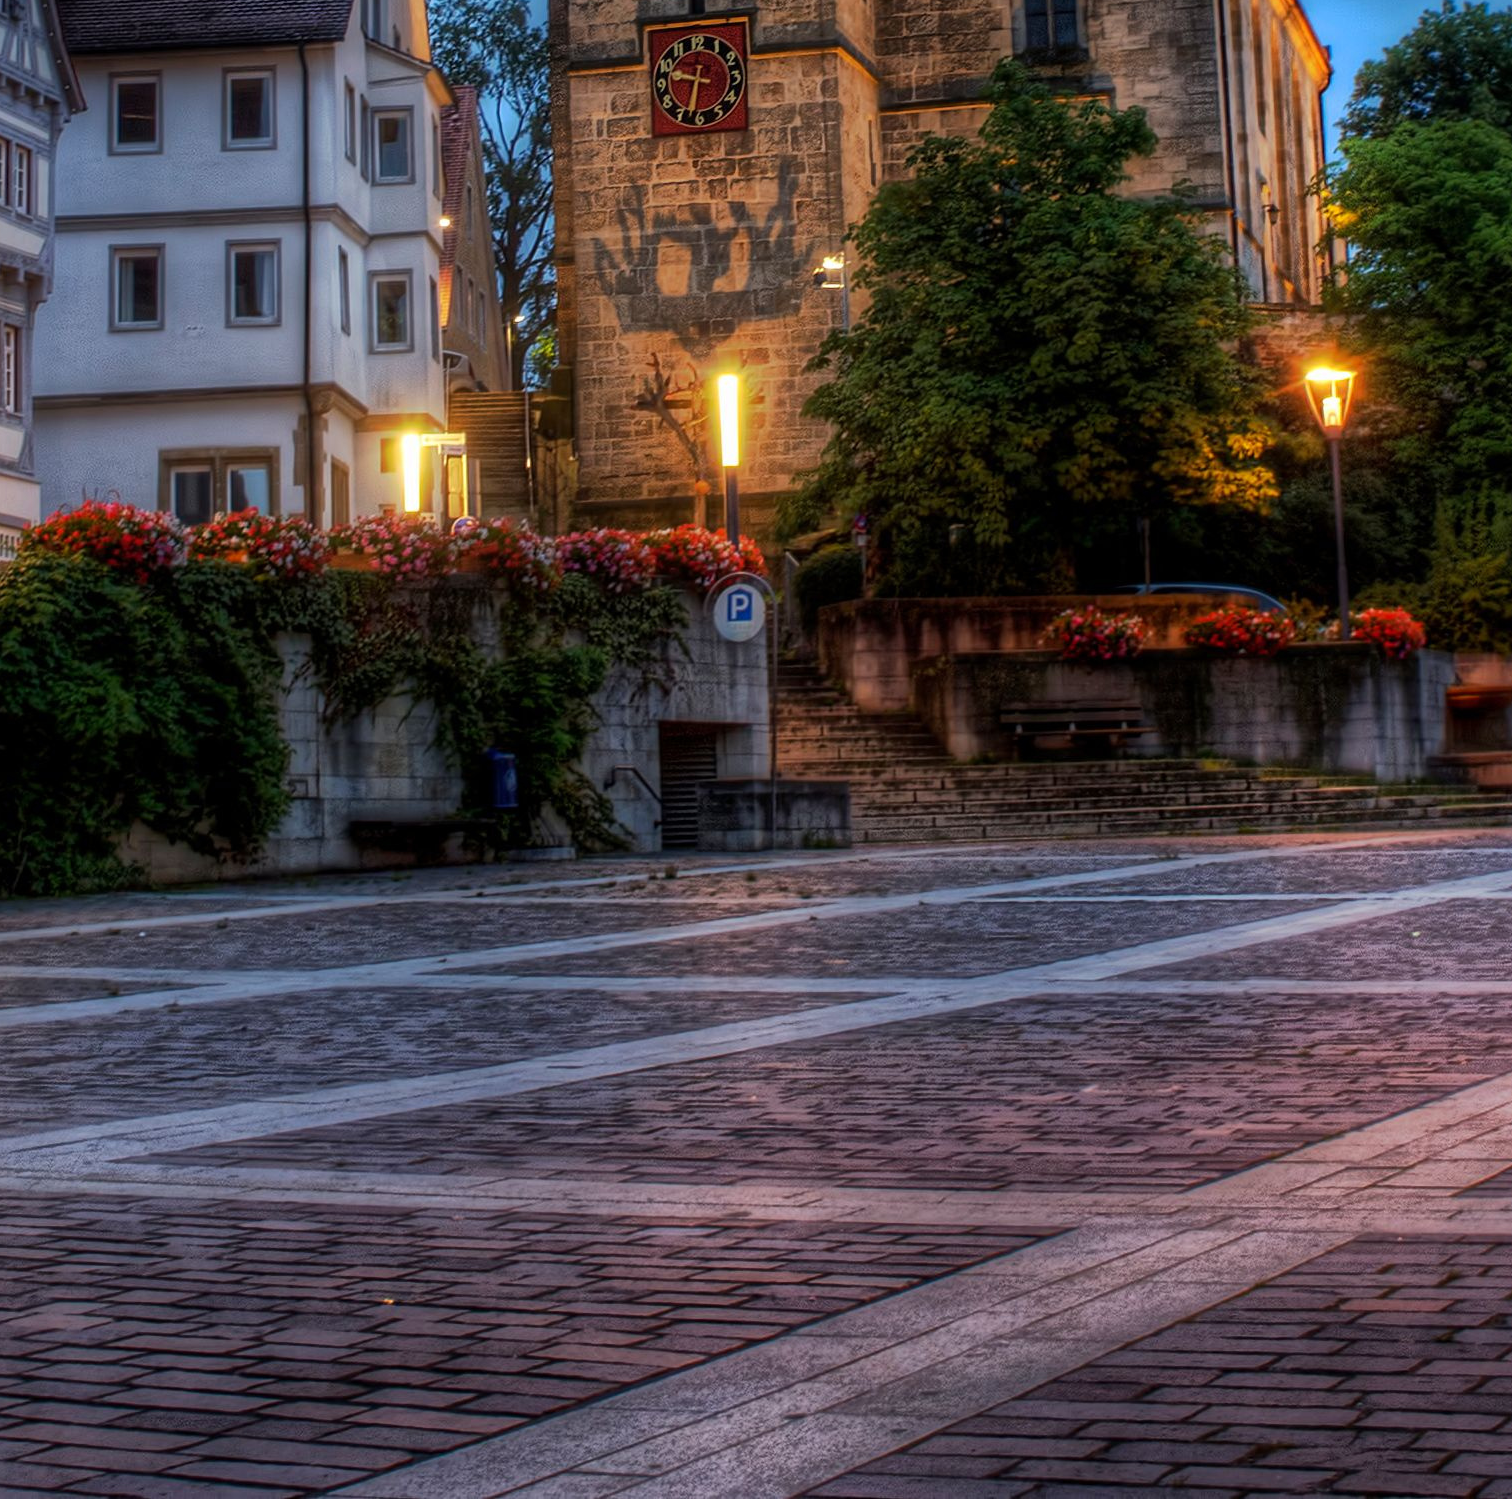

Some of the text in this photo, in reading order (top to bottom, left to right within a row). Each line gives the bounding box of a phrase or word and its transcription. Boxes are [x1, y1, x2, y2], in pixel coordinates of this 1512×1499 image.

[674, 43, 684, 57] 11
[691, 36, 705, 50] 12
[713, 40, 720, 53] 1
[660, 58, 673, 73] 10
[726, 51, 736, 66] 2
[730, 70, 741, 85] 3
[657, 78, 666, 92] 9
[662, 95, 673, 108] 8
[724, 90, 736, 104] 4
[676, 108, 685, 122] 7
[694, 111, 705, 125] 6
[714, 105, 723, 120] 5
[730, 594, 749, 619] P
